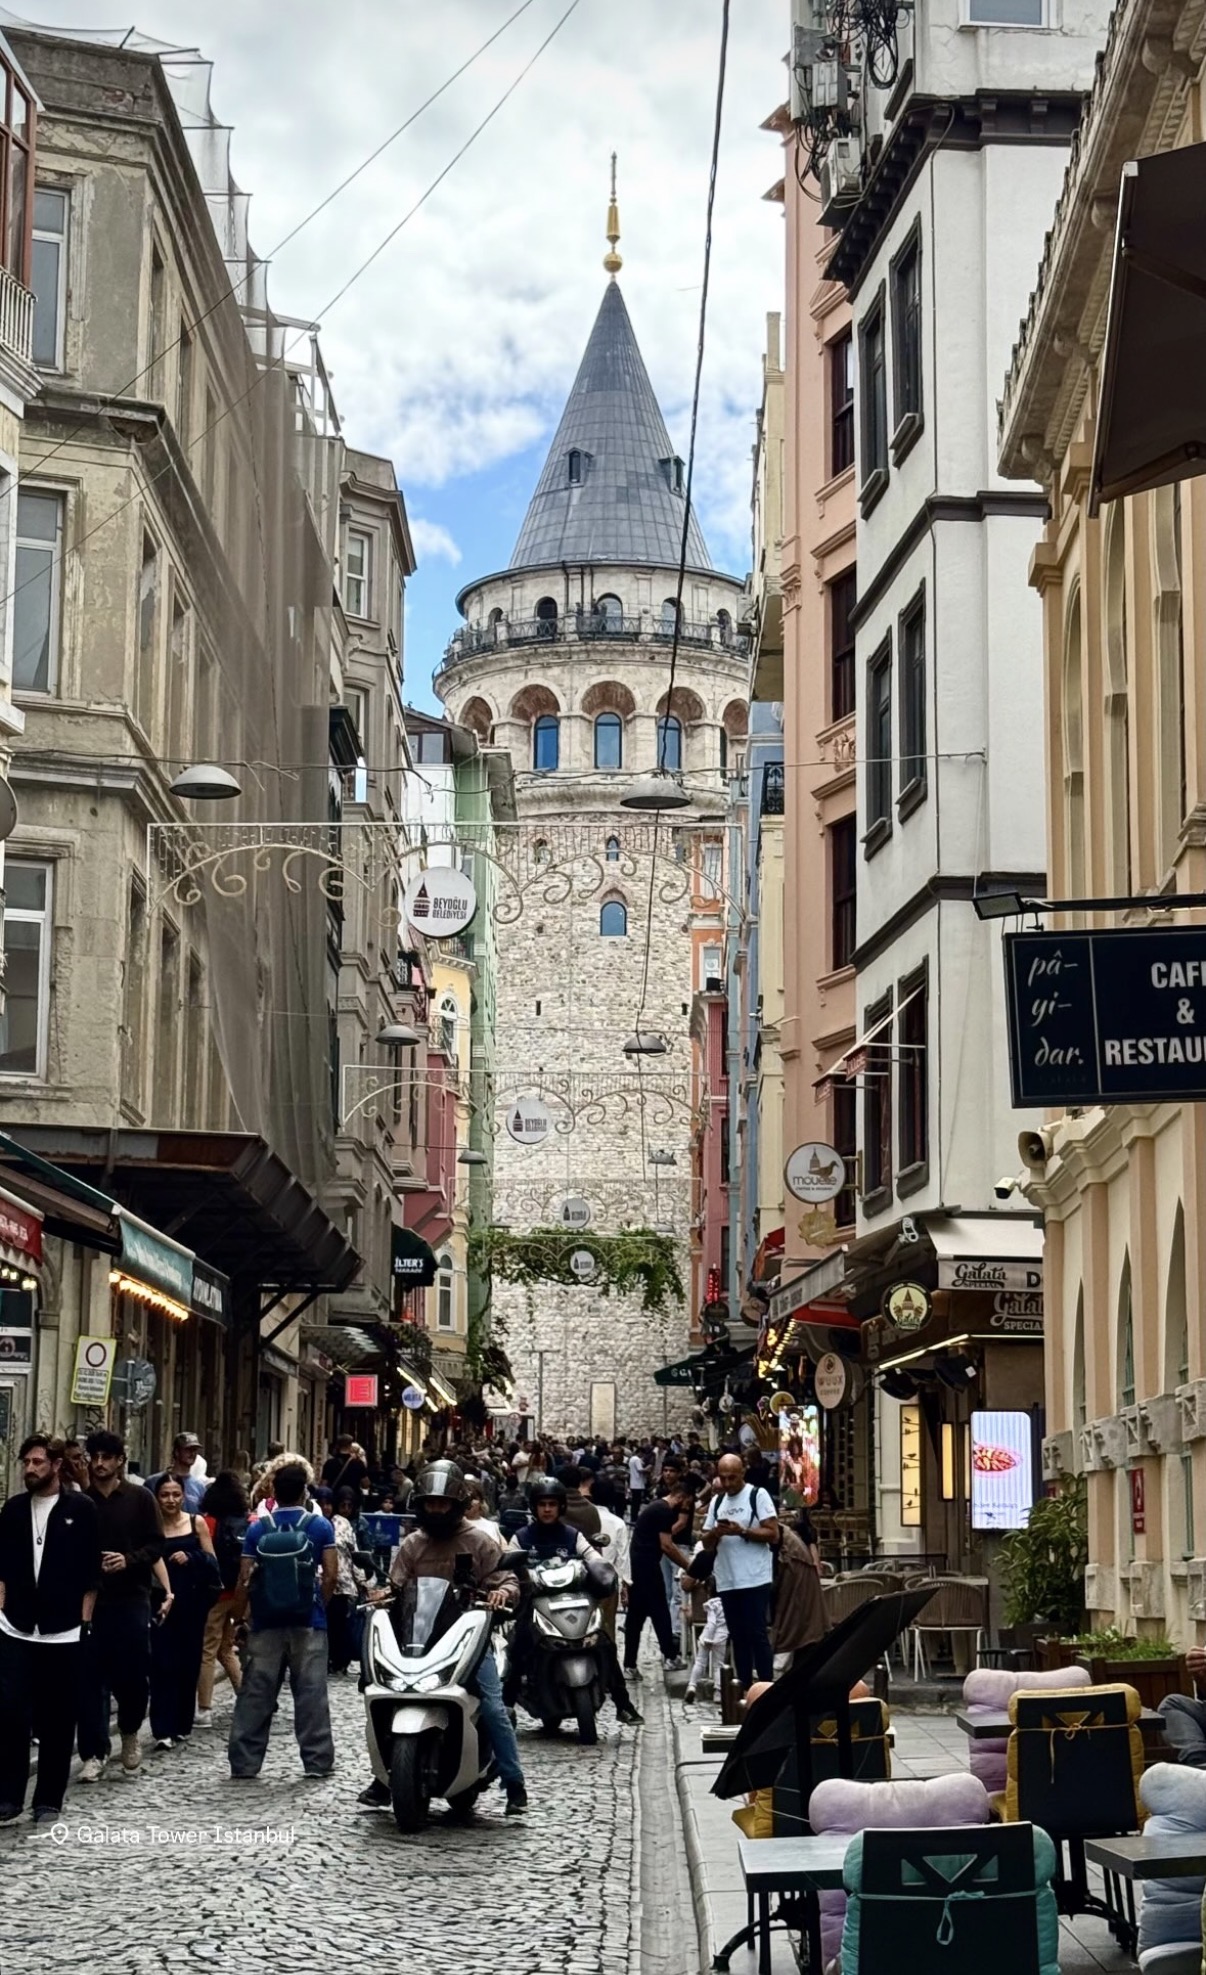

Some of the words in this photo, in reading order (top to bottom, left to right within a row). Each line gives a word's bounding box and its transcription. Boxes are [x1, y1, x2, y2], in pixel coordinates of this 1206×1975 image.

[433, 897, 468, 911] BEYOĞLU
[1176, 997, 1195, 1024] &
[1104, 1036, 1206, 1066] RESTAU
[951, 1262, 1007, 1288] Galata
[990, 1292, 1043, 1327] Galat
[1003, 1321, 1043, 1331] SPECIA
